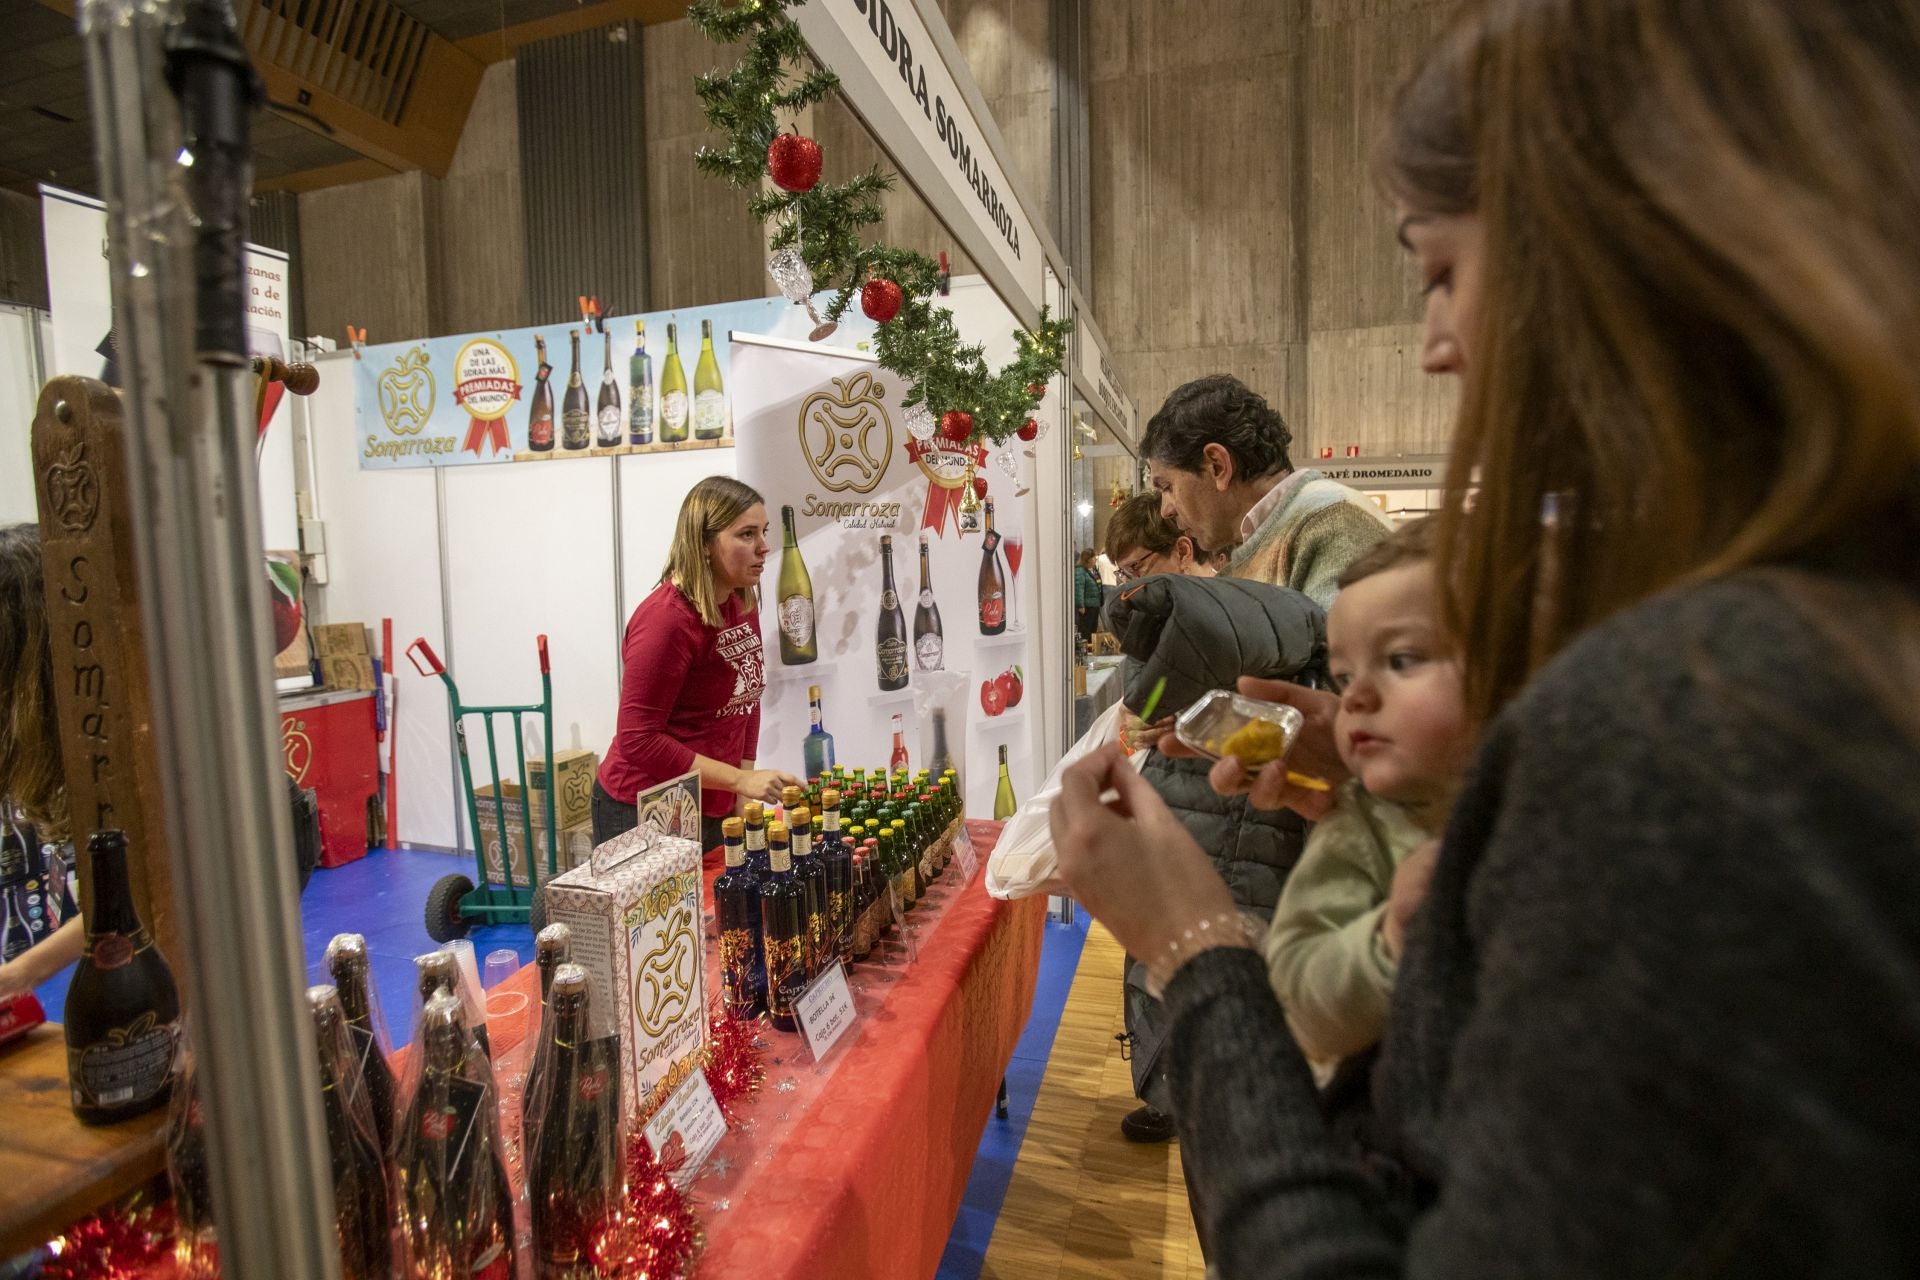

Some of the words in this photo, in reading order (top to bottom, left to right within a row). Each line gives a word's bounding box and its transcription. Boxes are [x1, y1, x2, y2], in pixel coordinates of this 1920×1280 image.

[854, 0, 931, 121] IDRA
[936, 95, 1020, 261] SOMARROZA
[247, 266, 280, 281] zanas
[264, 285, 280, 300] de
[472, 348, 490, 357] UNA
[482, 357, 496, 366] LAS
[460, 380, 514, 396] PREMIADAS
[364, 434, 457, 462] Somarroza
[1353, 468, 1432, 478] DROMEDARIO
[802, 494, 900, 522] Somarroza
[844, 519, 868, 529] Calidad
[870, 518, 896, 529] Natural
[61, 556, 116, 830] Somarr
[683, 815, 697, 838] 2€
[638, 1005, 700, 1071] Somarroza
